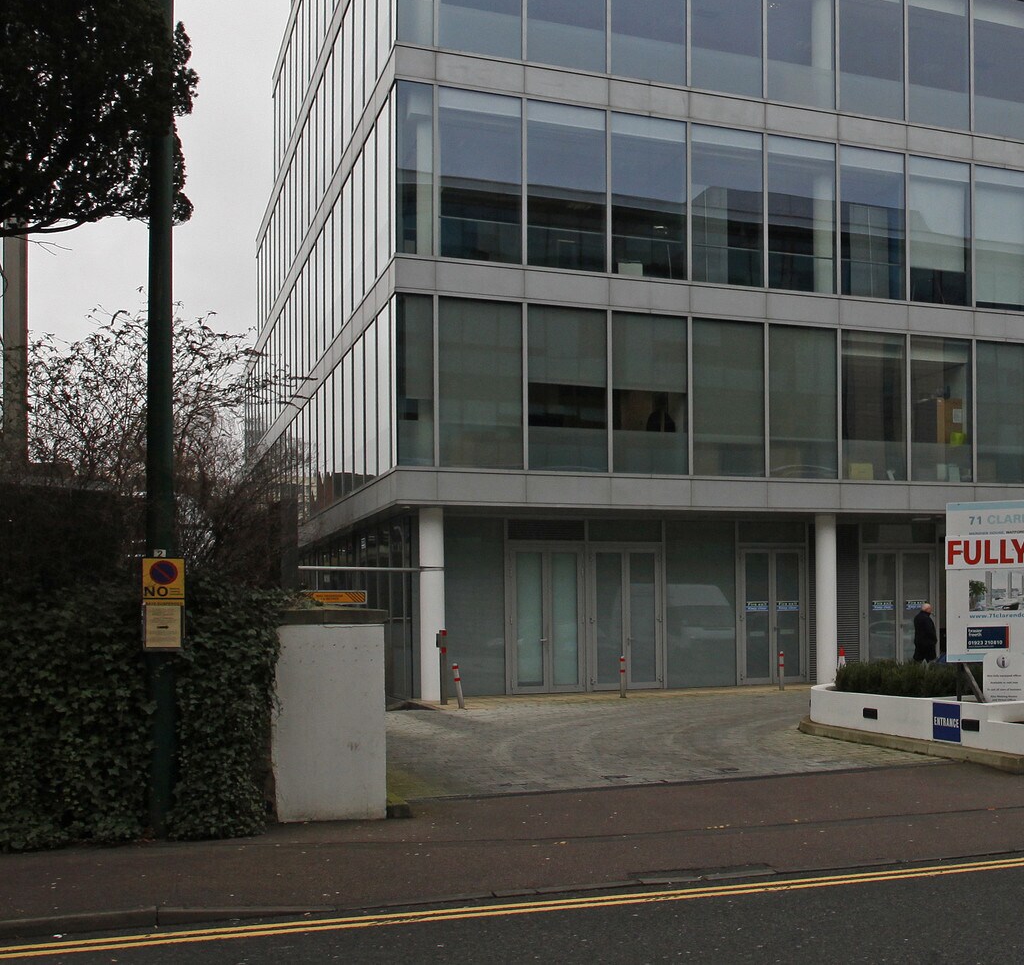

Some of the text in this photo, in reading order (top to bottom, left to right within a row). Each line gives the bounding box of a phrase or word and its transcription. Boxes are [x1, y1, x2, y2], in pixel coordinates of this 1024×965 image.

[969, 516, 982, 525] 71
[144, 586, 168, 596] NO
[934, 716, 959, 728] ENTRANCE
